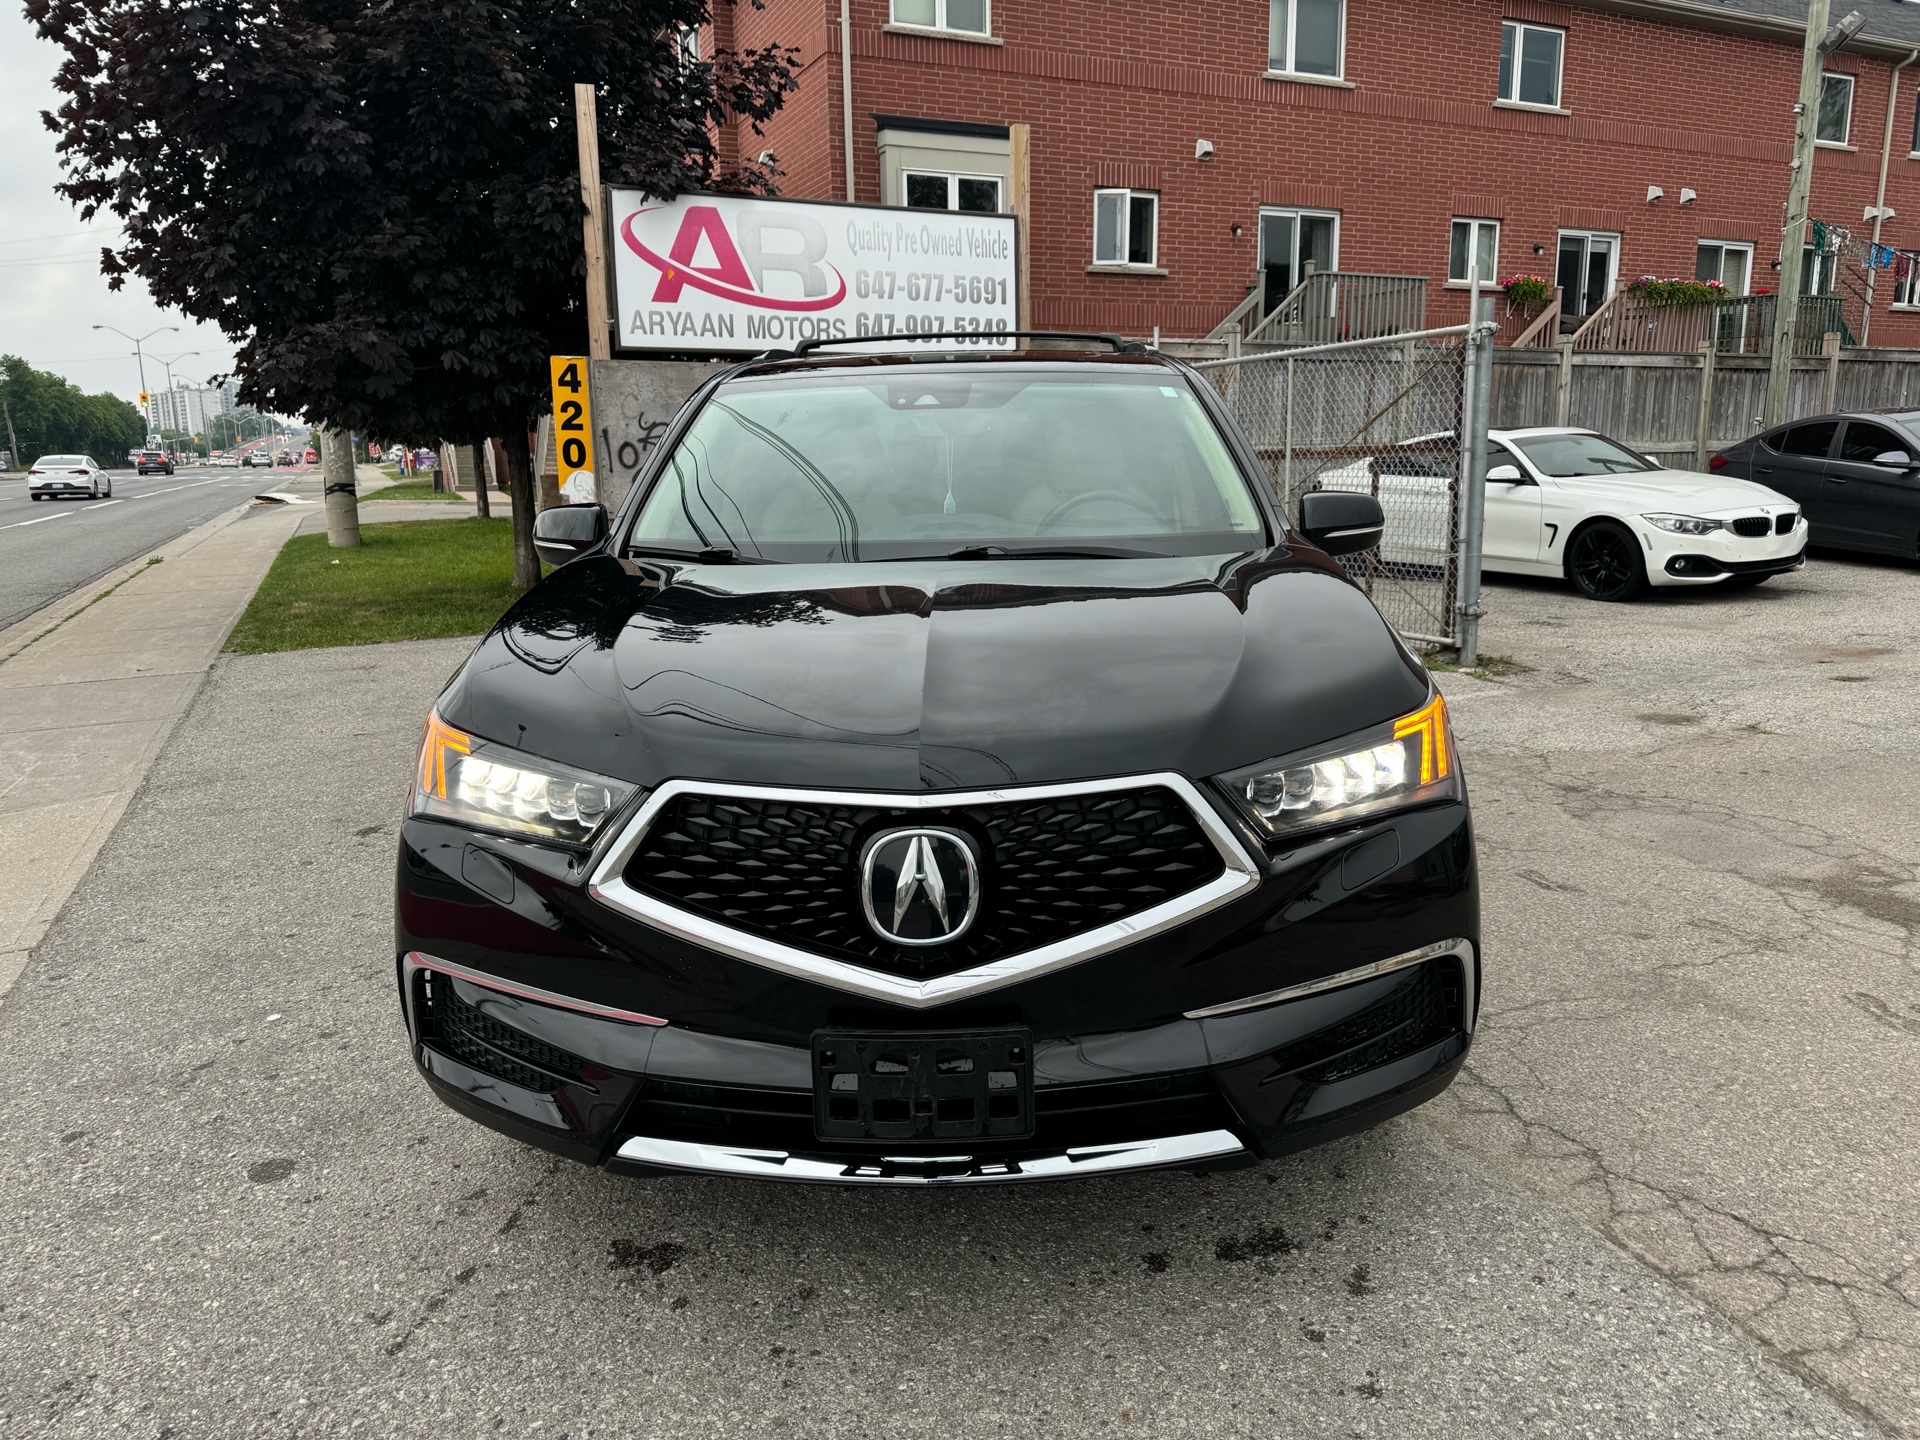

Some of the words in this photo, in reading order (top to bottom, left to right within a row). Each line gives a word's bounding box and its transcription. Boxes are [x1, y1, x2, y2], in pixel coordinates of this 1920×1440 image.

[650, 205, 828, 303] AR
[847, 219, 893, 261] Quality
[896, 222, 918, 254] Pre
[920, 224, 962, 257] Owned
[966, 227, 1008, 259] Vehicle
[855, 269, 1008, 305] 647-677-5691
[630, 309, 734, 338] ARYAAN
[747, 314, 846, 341] MOTORS
